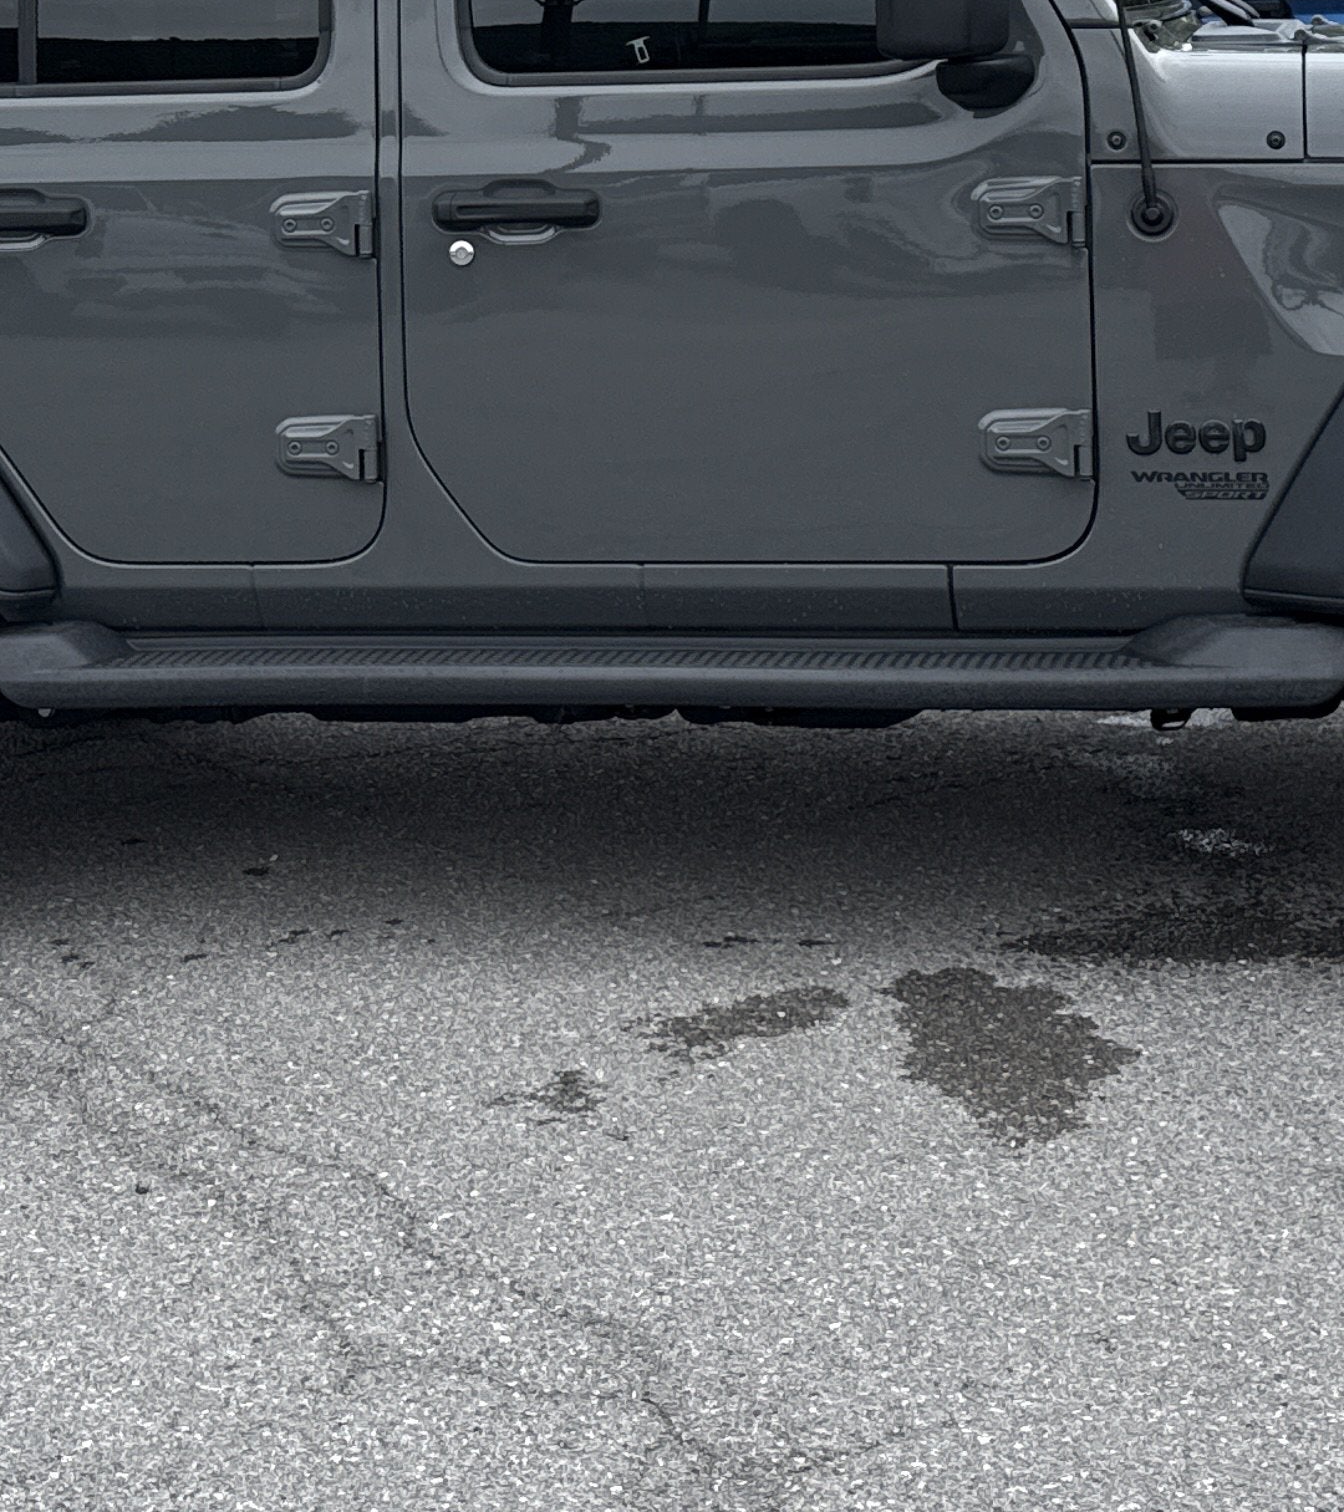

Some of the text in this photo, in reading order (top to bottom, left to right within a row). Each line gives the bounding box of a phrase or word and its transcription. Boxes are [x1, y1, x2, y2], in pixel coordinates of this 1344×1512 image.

[1126, 409, 1267, 463] Jeep
[1131, 471, 1269, 483] WRANGLER
[1184, 489, 1267, 500] SPORT
